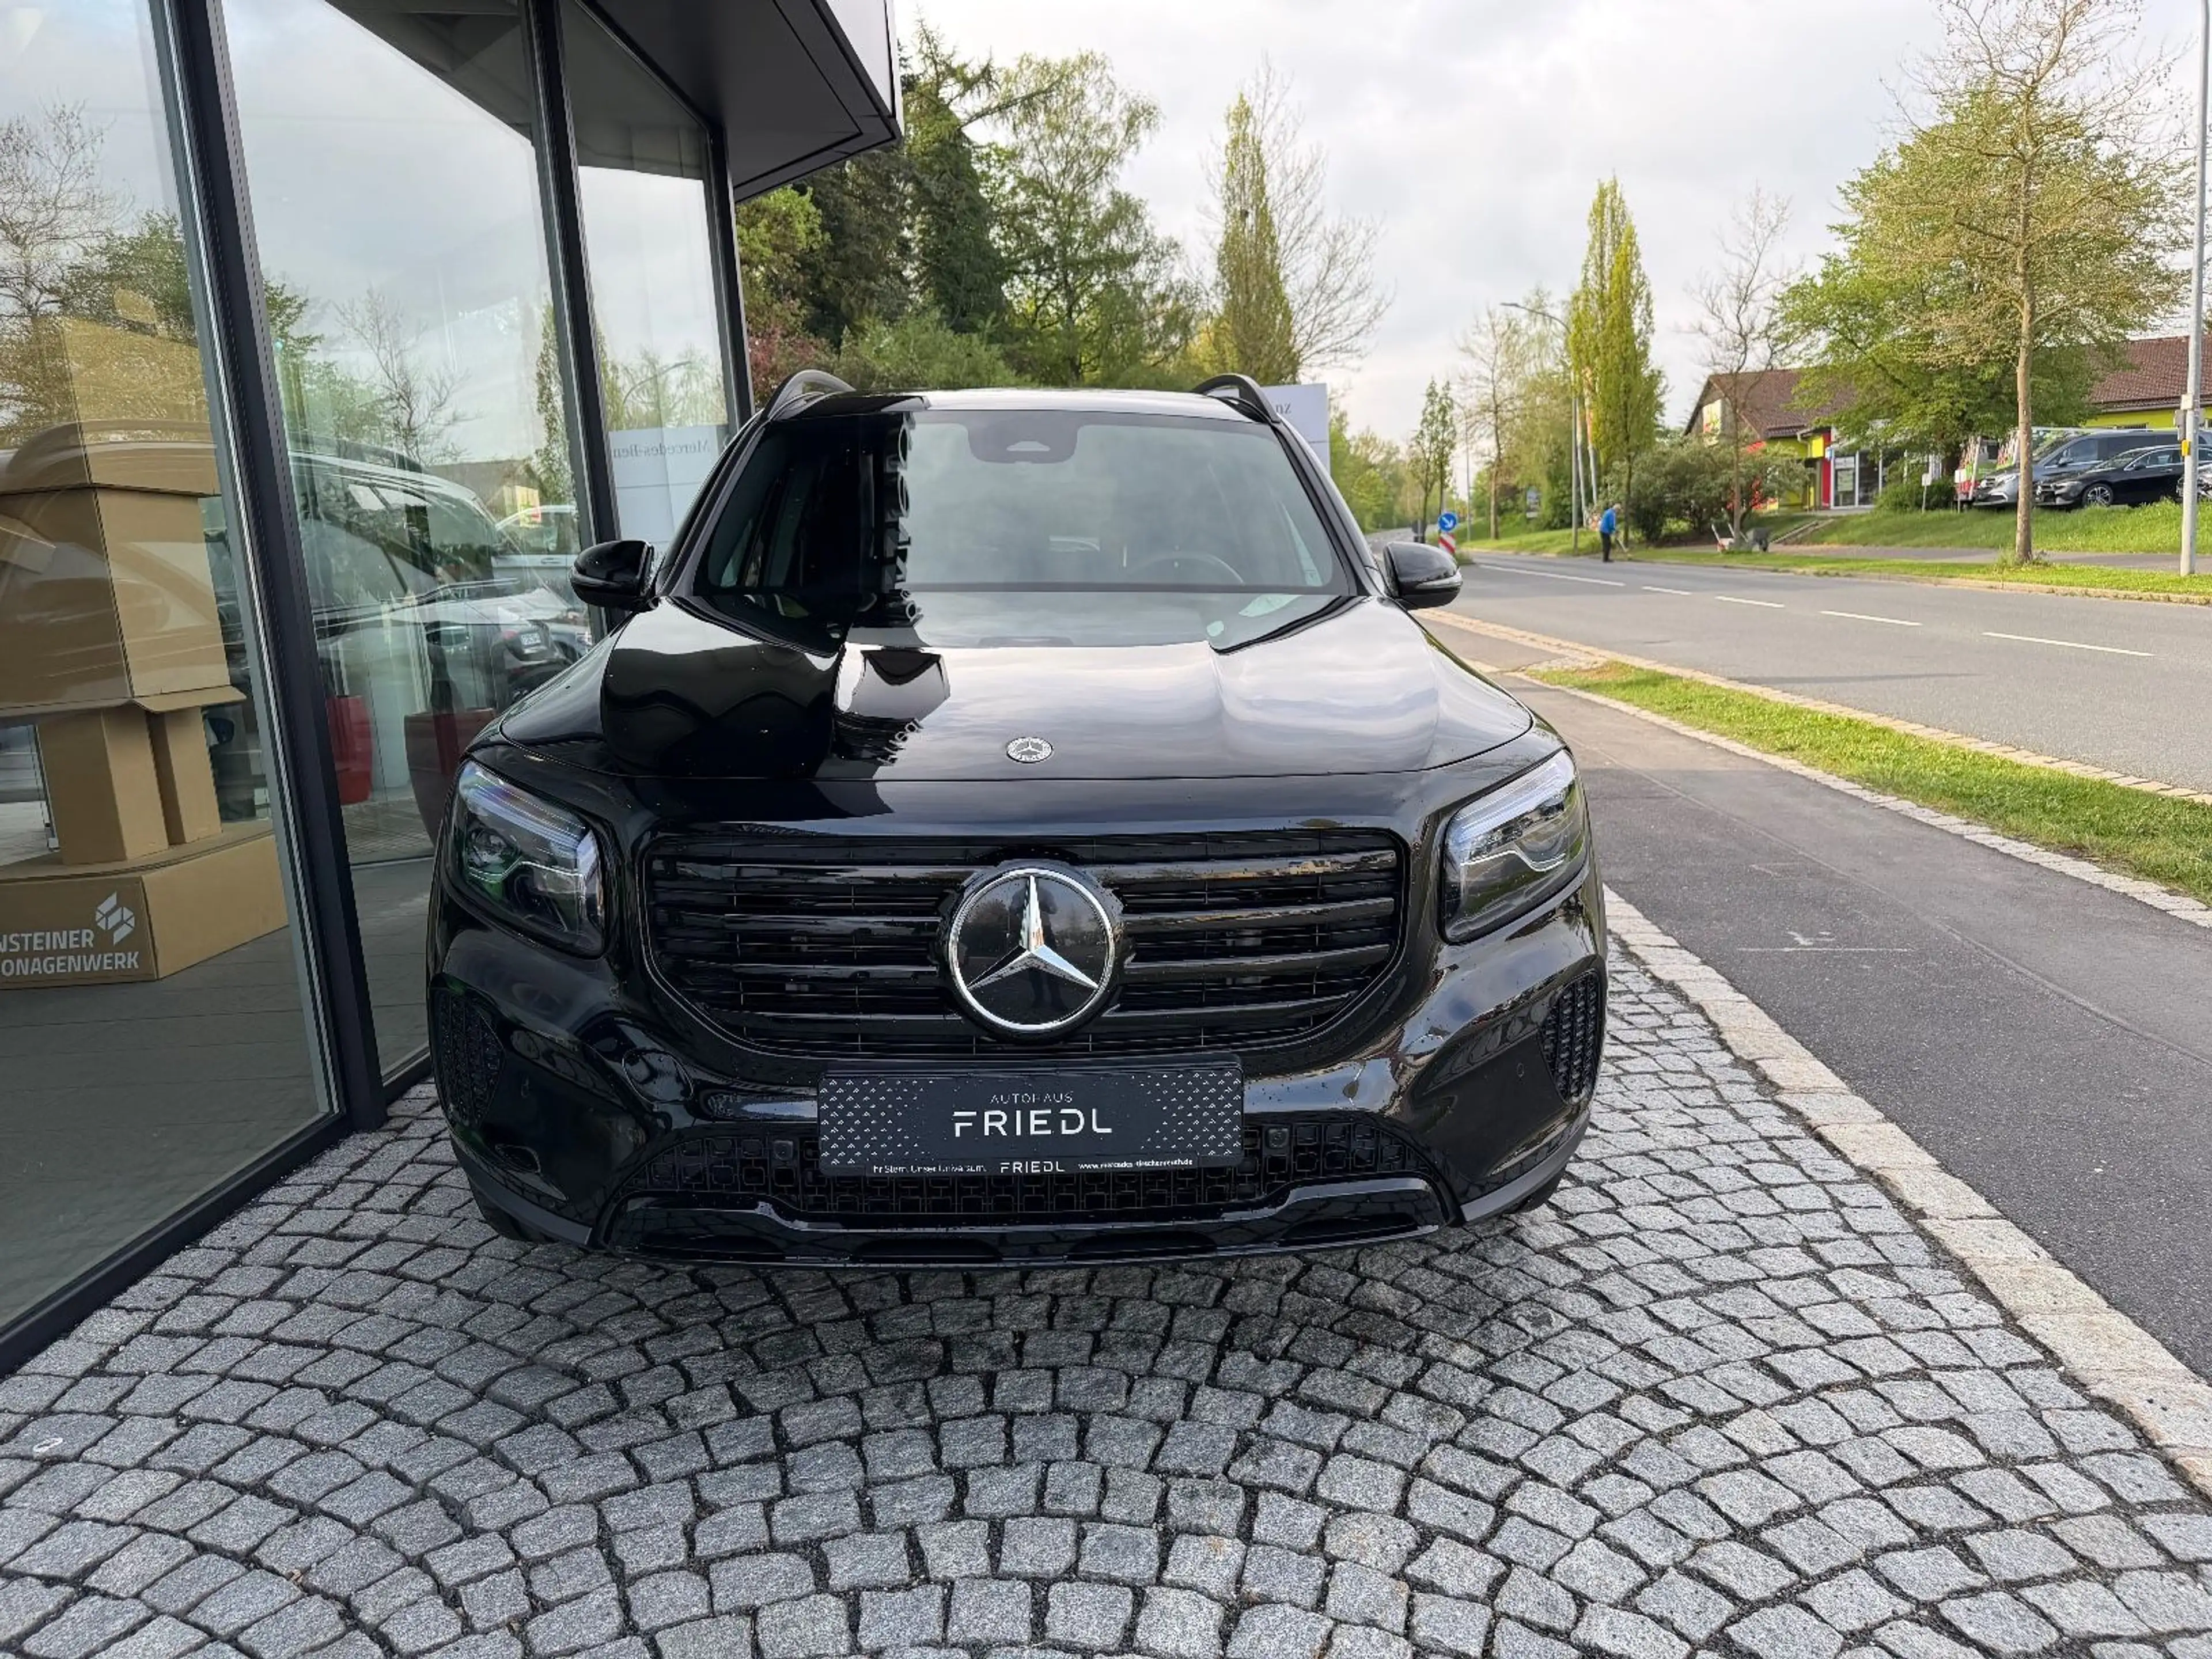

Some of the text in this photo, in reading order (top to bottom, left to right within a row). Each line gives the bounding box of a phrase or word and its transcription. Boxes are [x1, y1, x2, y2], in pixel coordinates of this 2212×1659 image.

[990, 1092, 1074, 1104] AUTOHAUS
[952, 1108, 1113, 1138] FRIEDL
[999, 1161, 1066, 1173] FRIEDL
